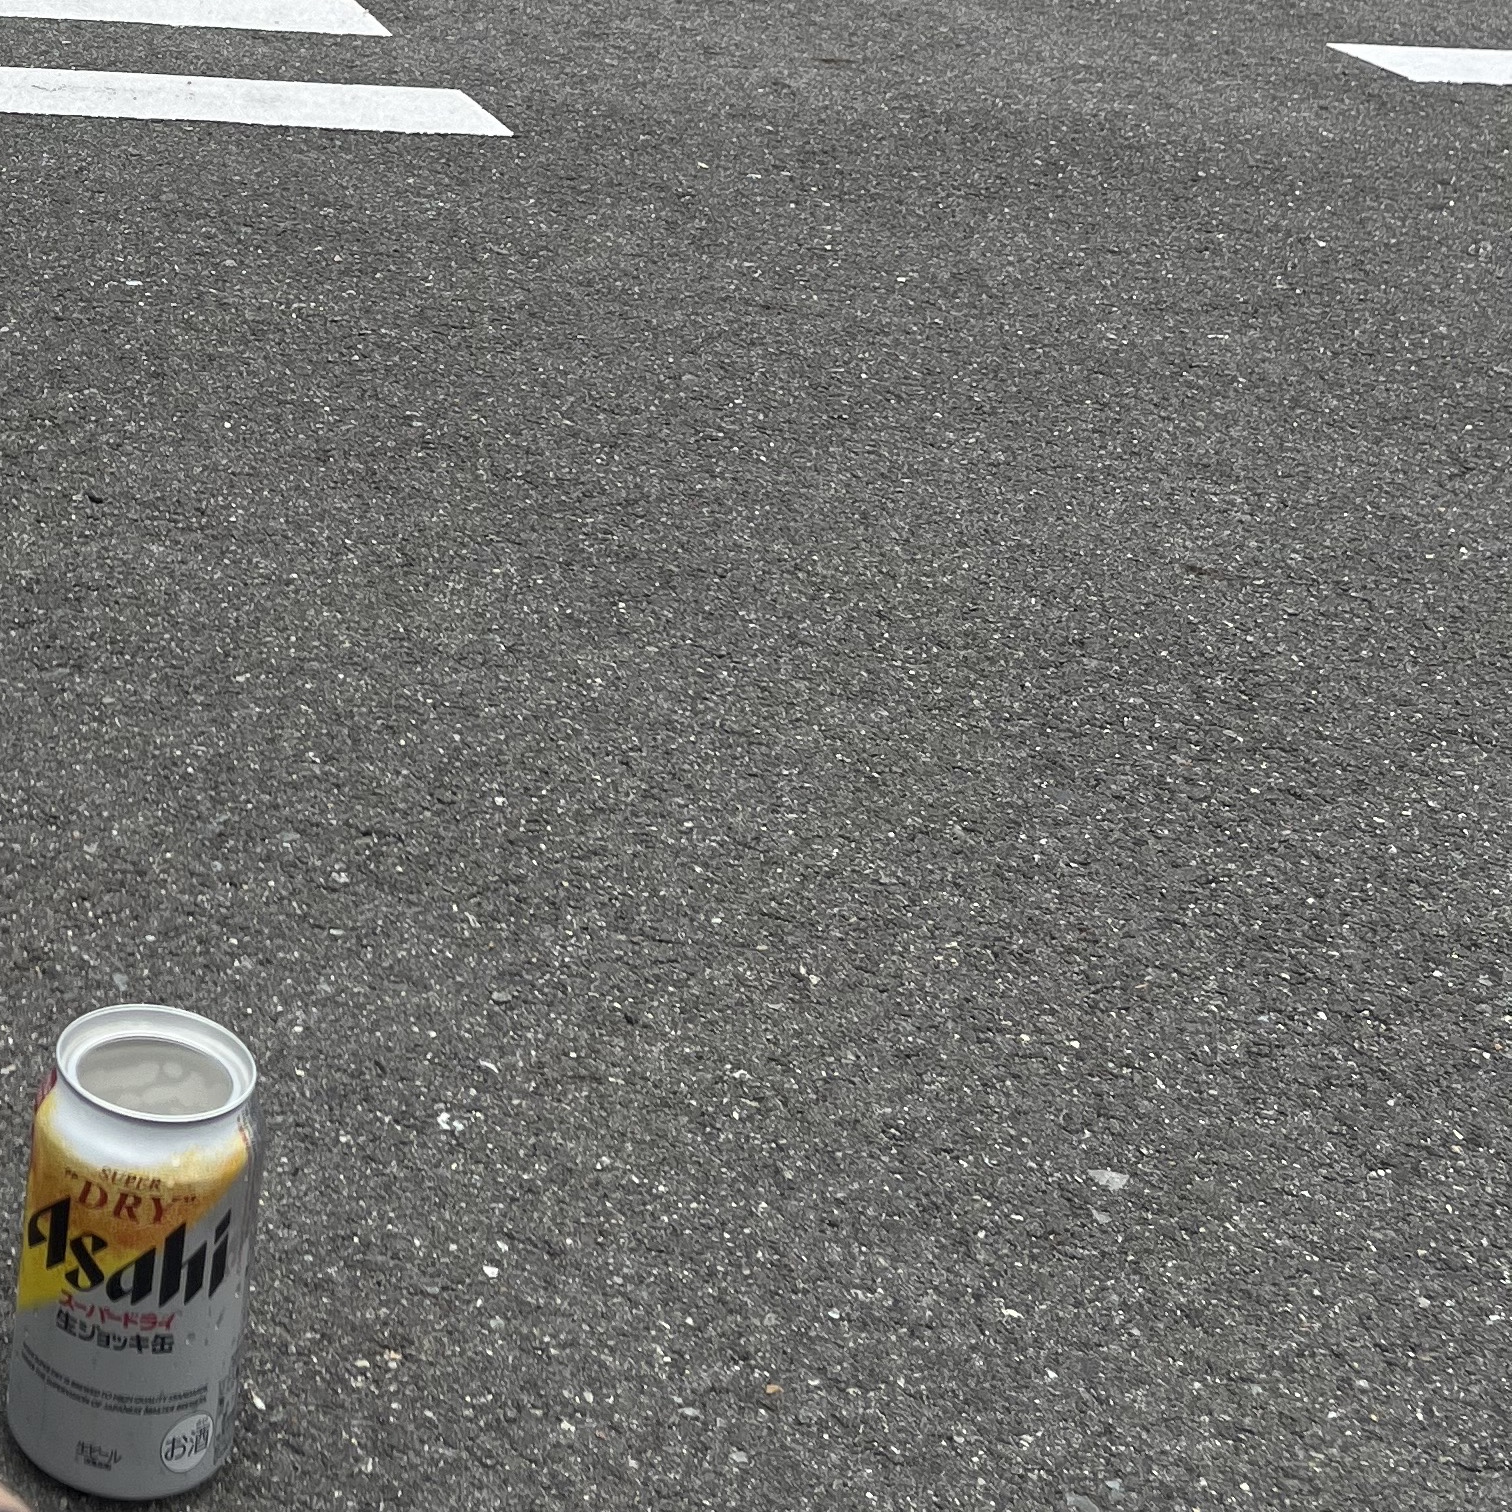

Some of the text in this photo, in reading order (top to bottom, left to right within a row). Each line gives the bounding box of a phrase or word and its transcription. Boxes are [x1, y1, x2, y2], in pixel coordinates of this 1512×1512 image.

[28, 1197, 232, 1309] Asahi
[55, 1307, 176, 1355] 生ジョッキ缶
[58, 1289, 177, 1331] スーパードライ
[164, 1428, 210, 1461] お酒
